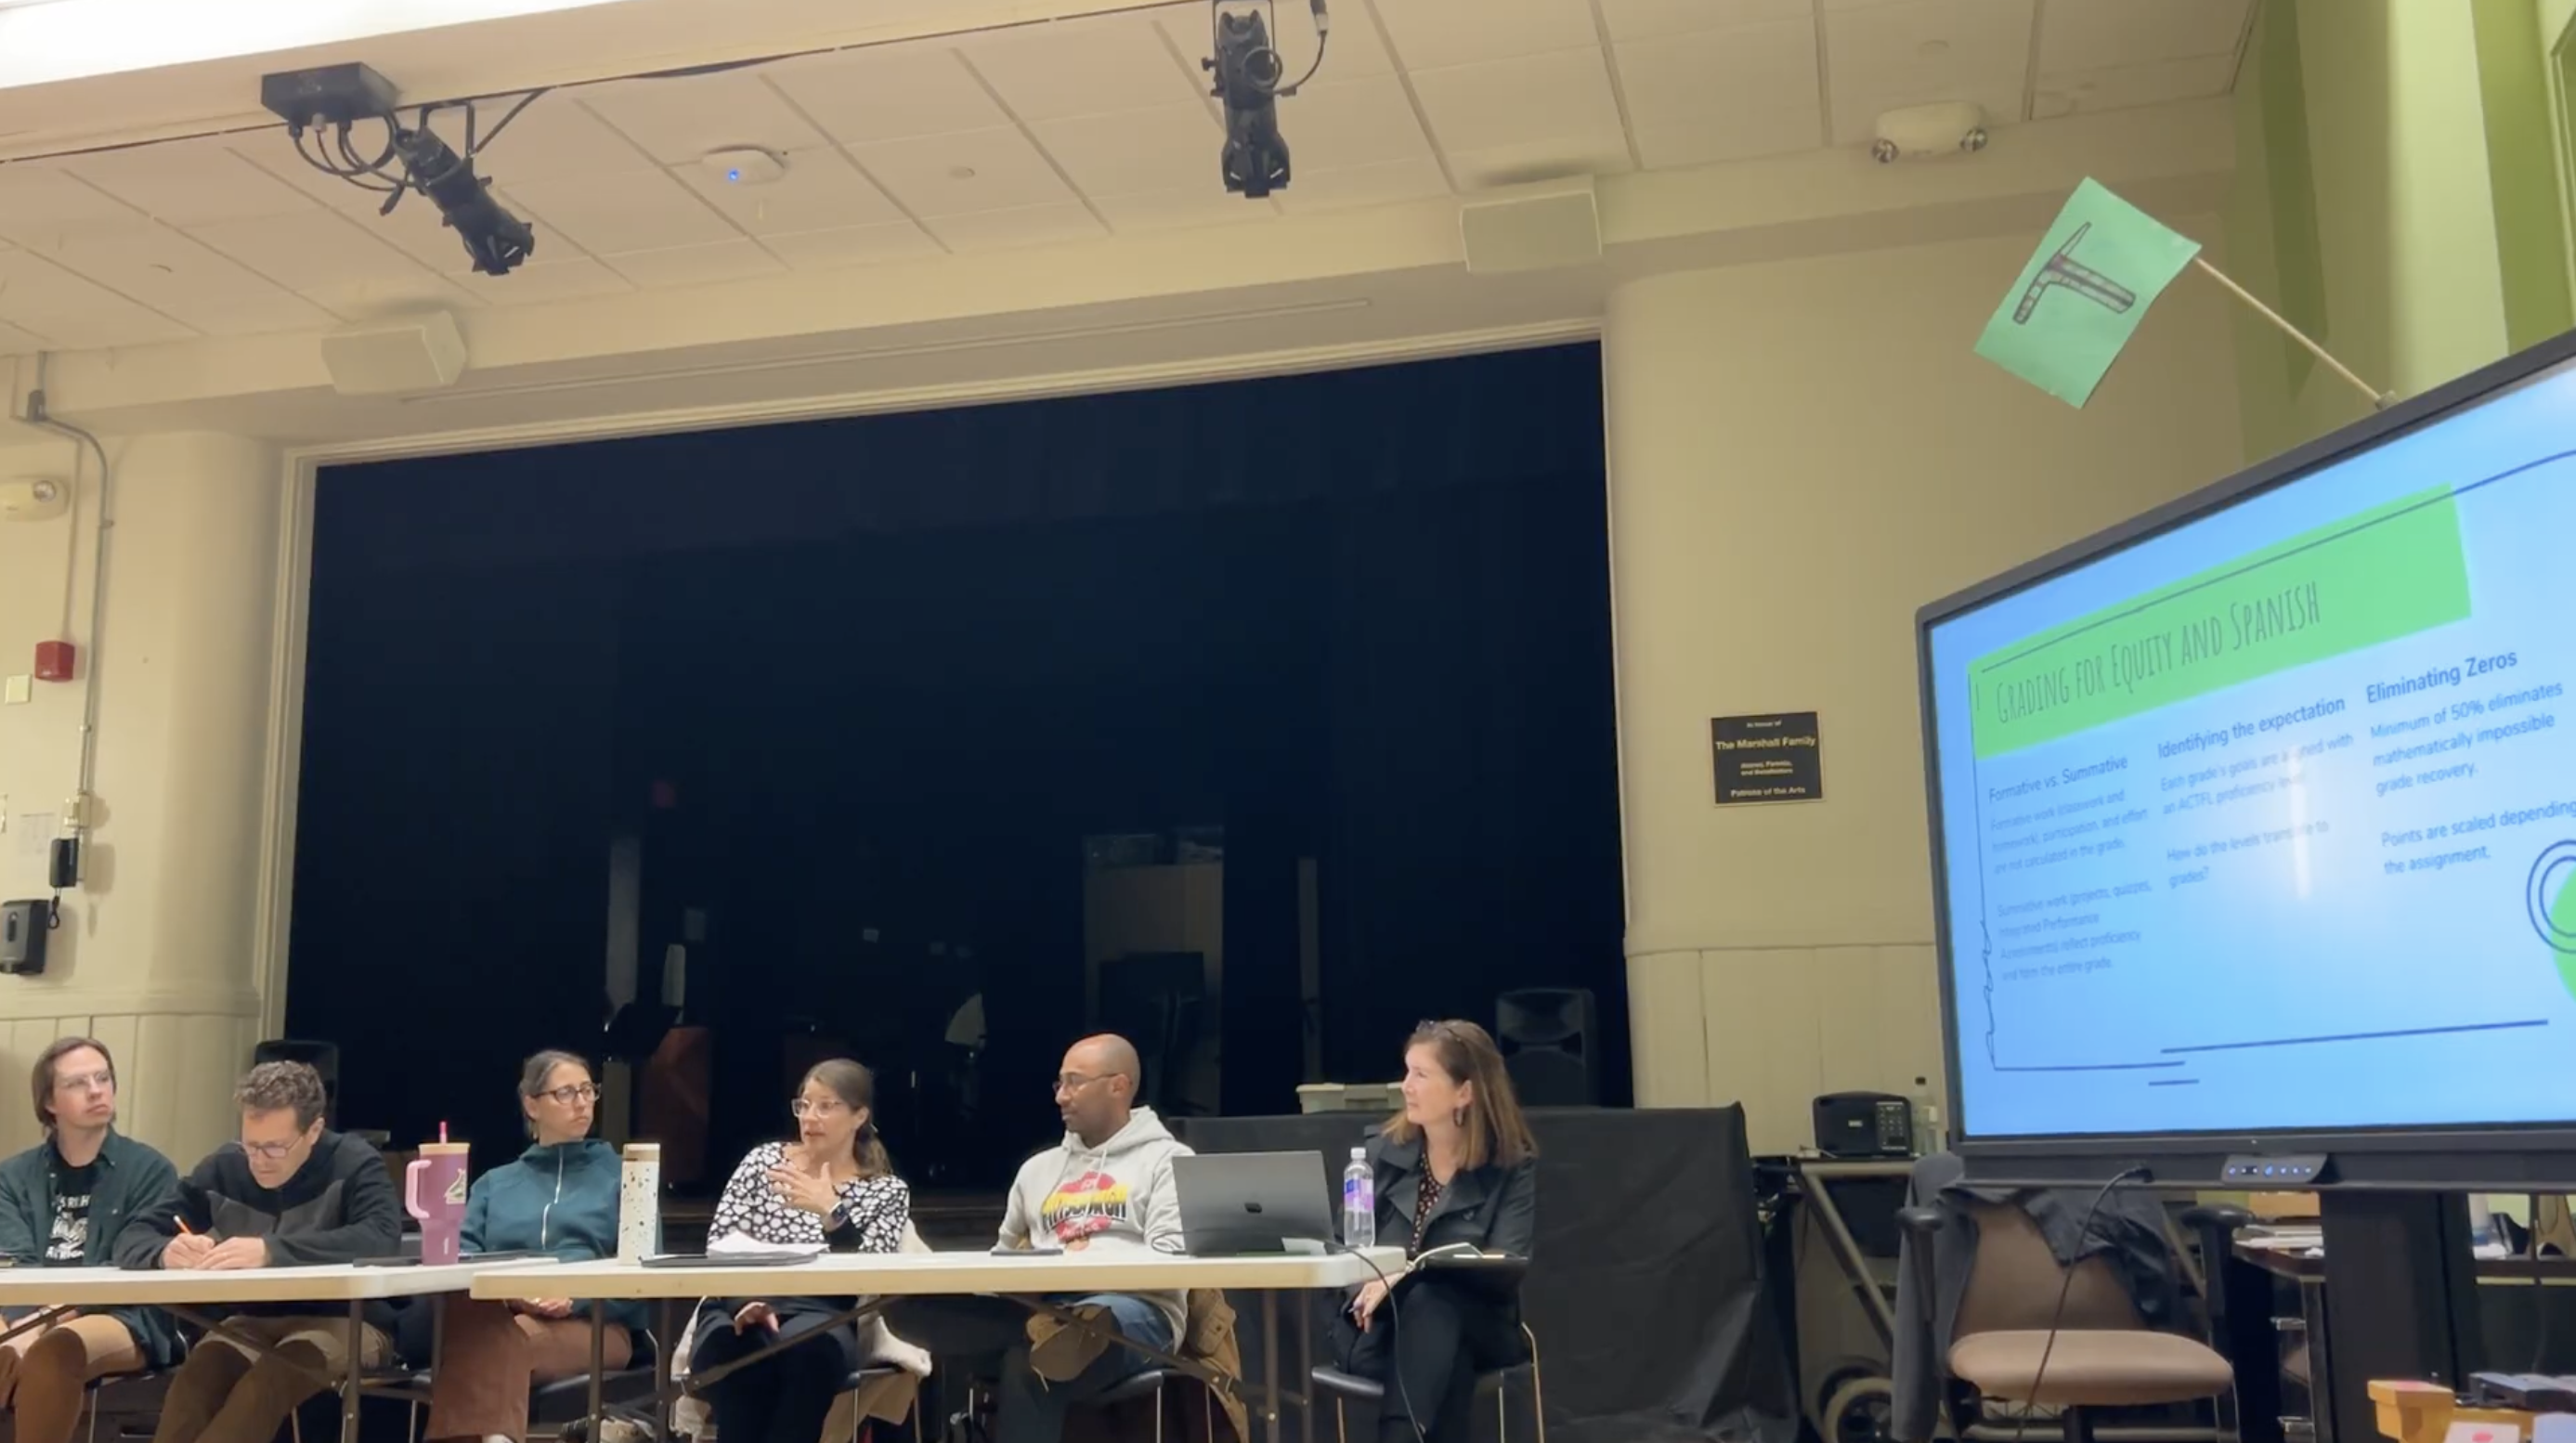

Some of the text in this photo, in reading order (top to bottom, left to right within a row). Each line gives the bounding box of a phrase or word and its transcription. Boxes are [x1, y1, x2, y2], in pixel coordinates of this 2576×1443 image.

[2366, 652, 2517, 703] Eliminating Zeros
[2157, 697, 2346, 759] Identifying the expectation
[2370, 682, 2564, 738] Minimum of 50% eliminates
[1716, 736, 1816, 750] The Marshall Family
[2373, 713, 2556, 767] mathematically impossible
[1989, 756, 2128, 804] Formative vs. Summative
[2160, 774, 2185, 792] Each
[2327, 733, 2354, 750] with
[2375, 761, 2478, 798] grade recovery.
[1730, 786, 1806, 798] Patrons of the Arts
[2106, 789, 2125, 804] and
[2163, 801, 2176, 814] an
[2178, 792, 2214, 811] ACTFL
[2216, 780, 2276, 805] proficiency
[2102, 814, 2120, 828] and
[2381, 800, 2576, 848] Points are scaled depending
[2166, 848, 2191, 862] How
[2193, 844, 2208, 858] do
[2210, 840, 2227, 854] the
[2384, 845, 2492, 875] the assignment.
